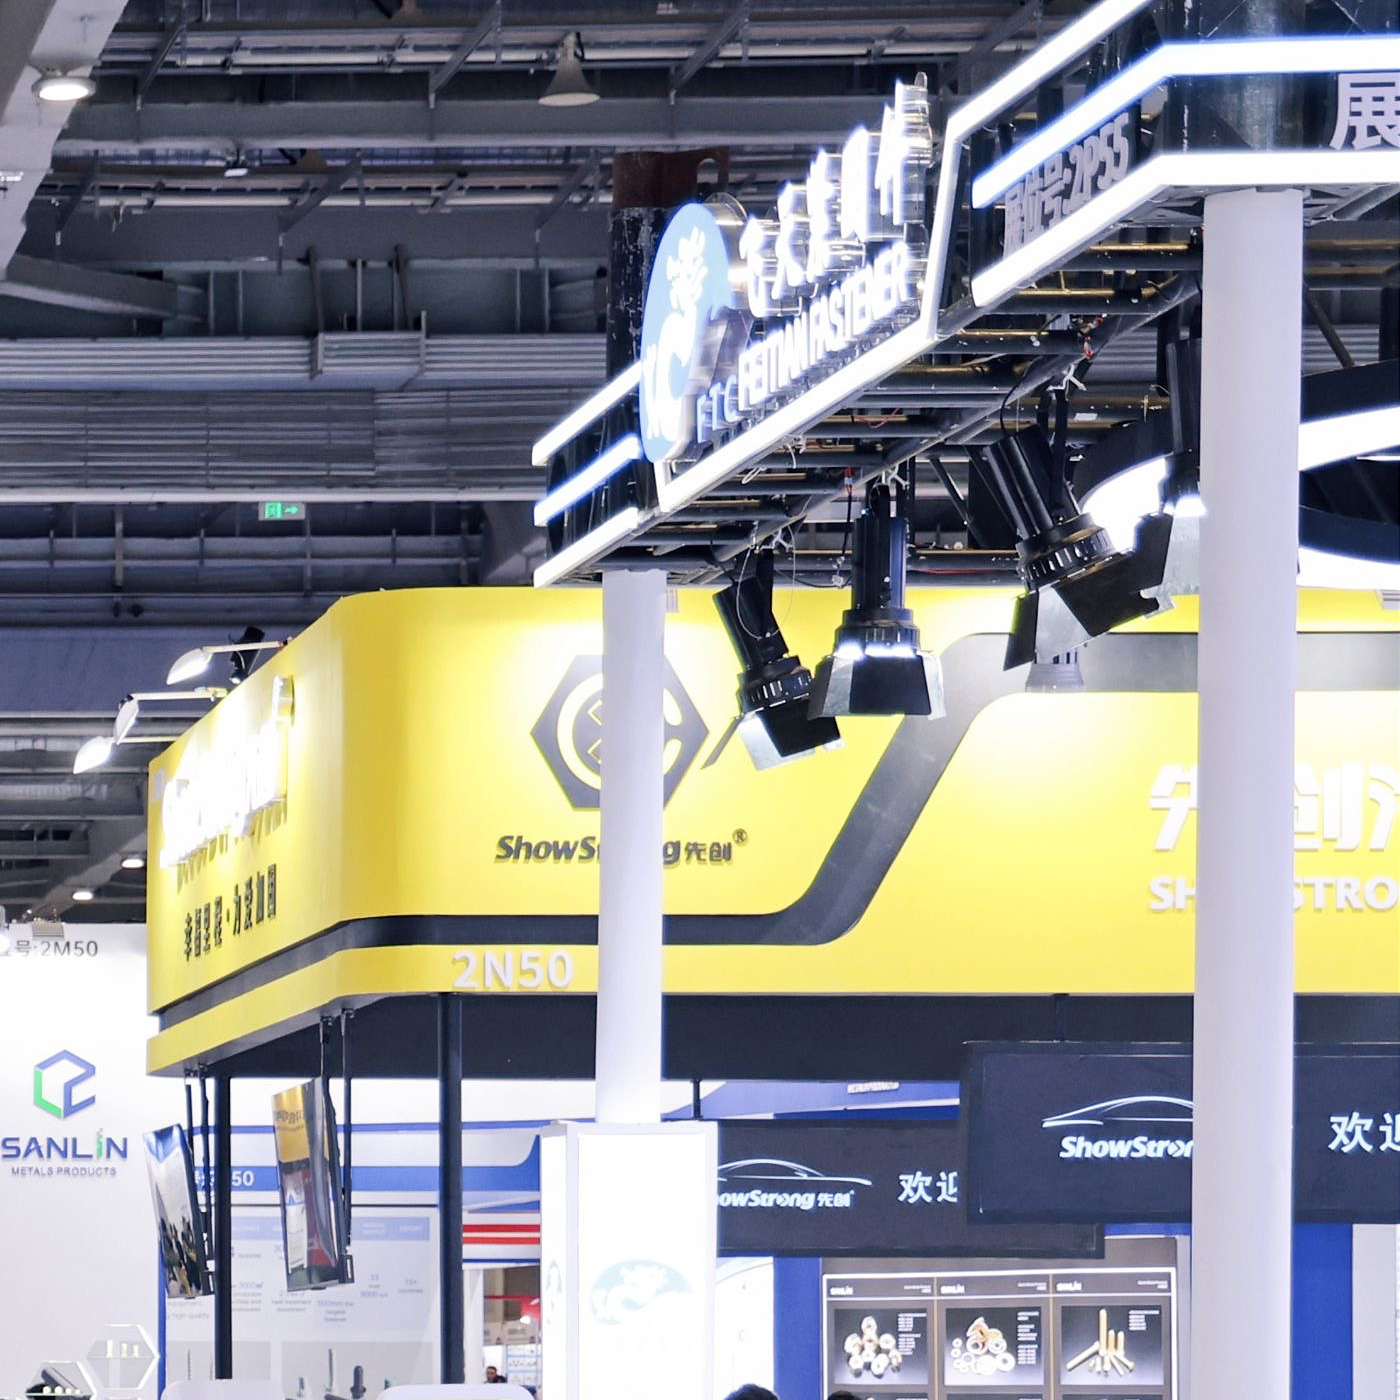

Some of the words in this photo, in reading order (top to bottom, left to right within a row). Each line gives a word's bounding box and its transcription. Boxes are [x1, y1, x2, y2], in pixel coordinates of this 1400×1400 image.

[451, 950, 575, 989] 2N50
[10, 1166, 54, 1177] METALS
[56, 1166, 117, 1178] PRODUCTS
[716, 1189, 815, 1210] owStrong
